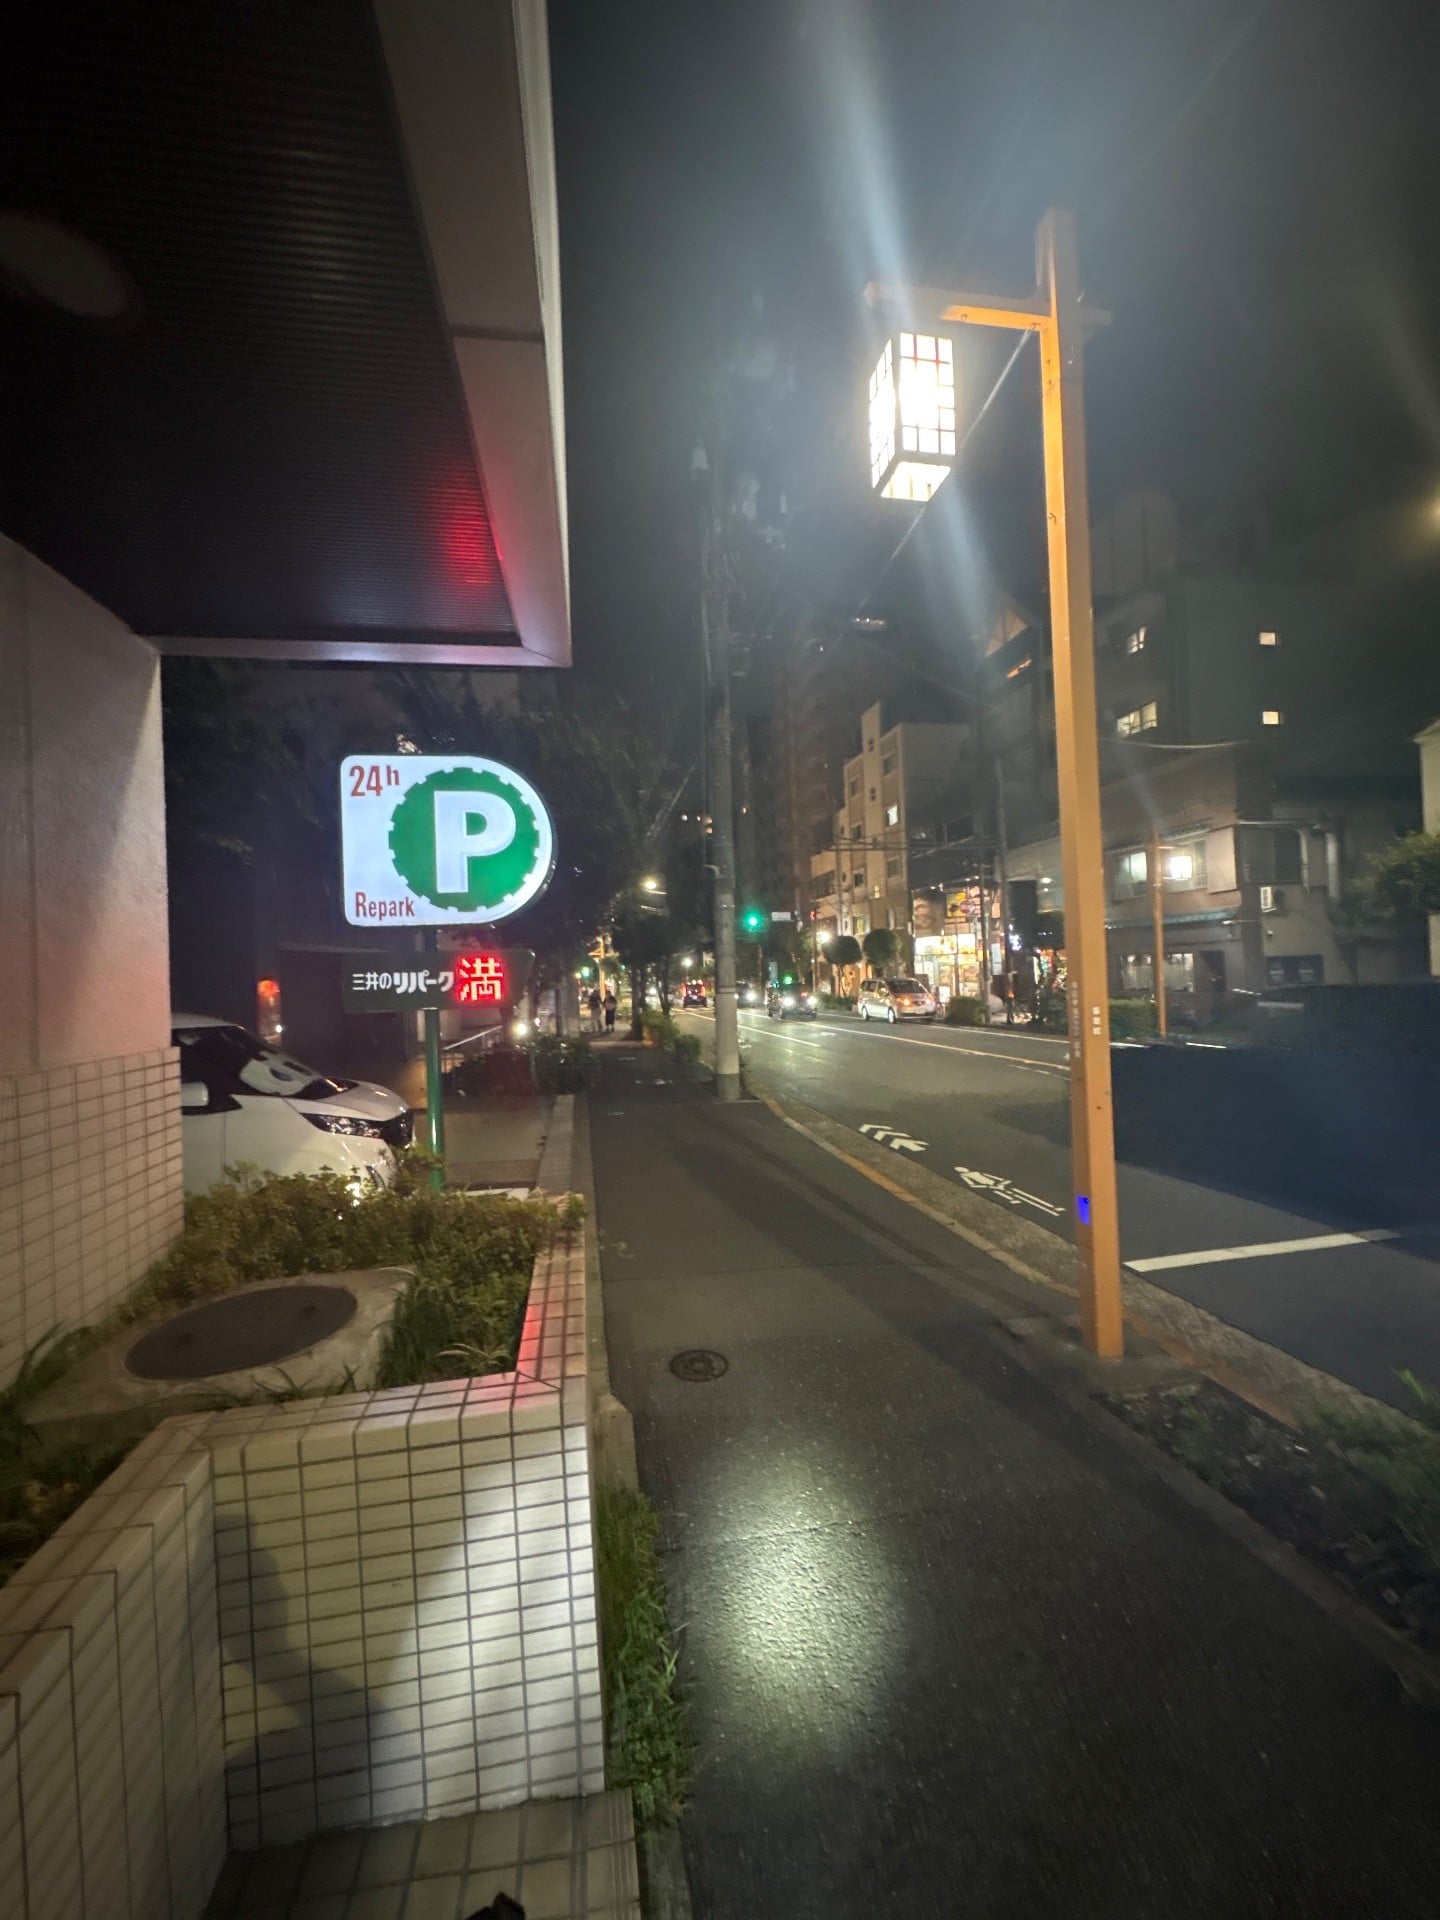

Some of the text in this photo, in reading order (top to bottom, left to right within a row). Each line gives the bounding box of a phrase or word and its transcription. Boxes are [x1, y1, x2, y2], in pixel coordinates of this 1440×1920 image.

[350, 765, 400, 797] 24h
[434, 790, 517, 894] P
[355, 891, 415, 920] Repark
[352, 969, 455, 994] 三井のリパーク
[459, 957, 503, 1001] 満
